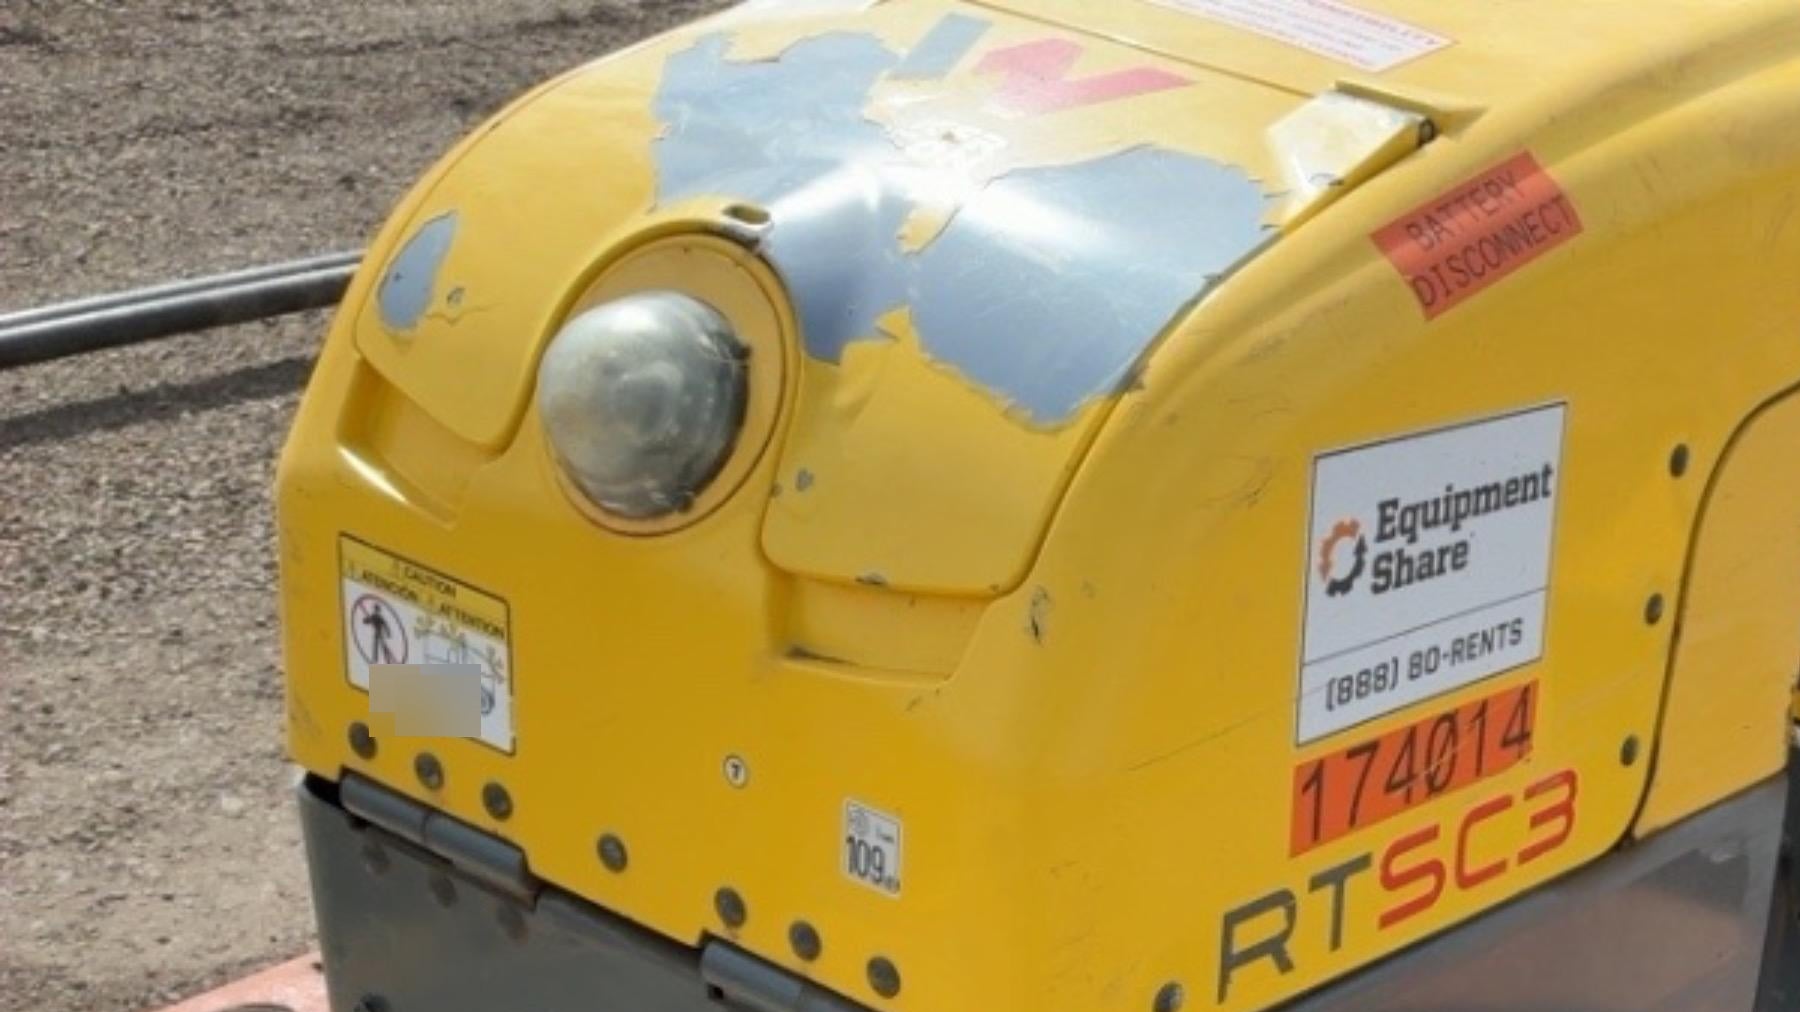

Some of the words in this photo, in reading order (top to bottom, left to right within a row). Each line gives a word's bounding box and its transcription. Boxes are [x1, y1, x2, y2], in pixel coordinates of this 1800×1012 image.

[1405, 169, 1526, 251] BATTERY
[1410, 193, 1573, 307] DISCONNECT
[1374, 462, 1554, 544] Equipment
[1370, 539, 1470, 595] Share
[1325, 657, 1400, 712] (888)
[1407, 618, 1524, 682] 80-RENTS
[1302, 684, 1533, 842] 174014
[846, 834, 886, 885] 109
[1217, 769, 1578, 1005] RTSC3
